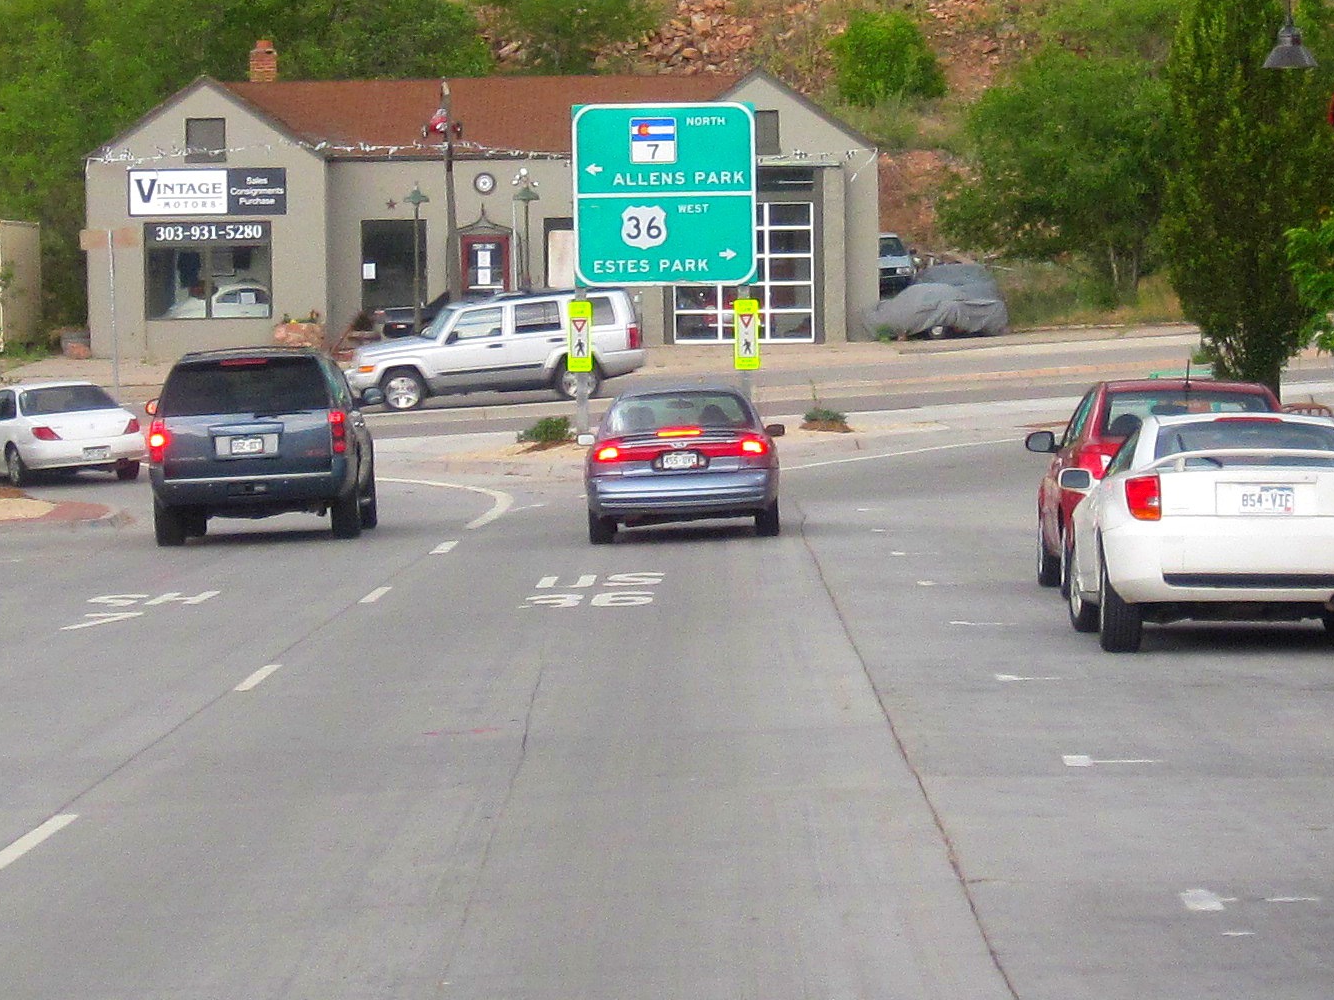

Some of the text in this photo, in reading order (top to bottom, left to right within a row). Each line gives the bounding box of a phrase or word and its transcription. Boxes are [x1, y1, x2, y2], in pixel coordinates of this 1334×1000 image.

[686, 116, 725, 126] NORTH
[646, 143, 659, 160] 7
[613, 170, 745, 186] ALLENS PARK
[134, 178, 223, 204] VINTAGE
[230, 187, 284, 197] Consignments
[238, 197, 276, 206] Purchase
[677, 204, 709, 213] WEST
[155, 225, 262, 241] 303-931-5280
[625, 215, 662, 239] 36
[593, 258, 709, 274] ESTES PARK
[535, 571, 665, 589] US
[518, 591, 655, 609] 36
